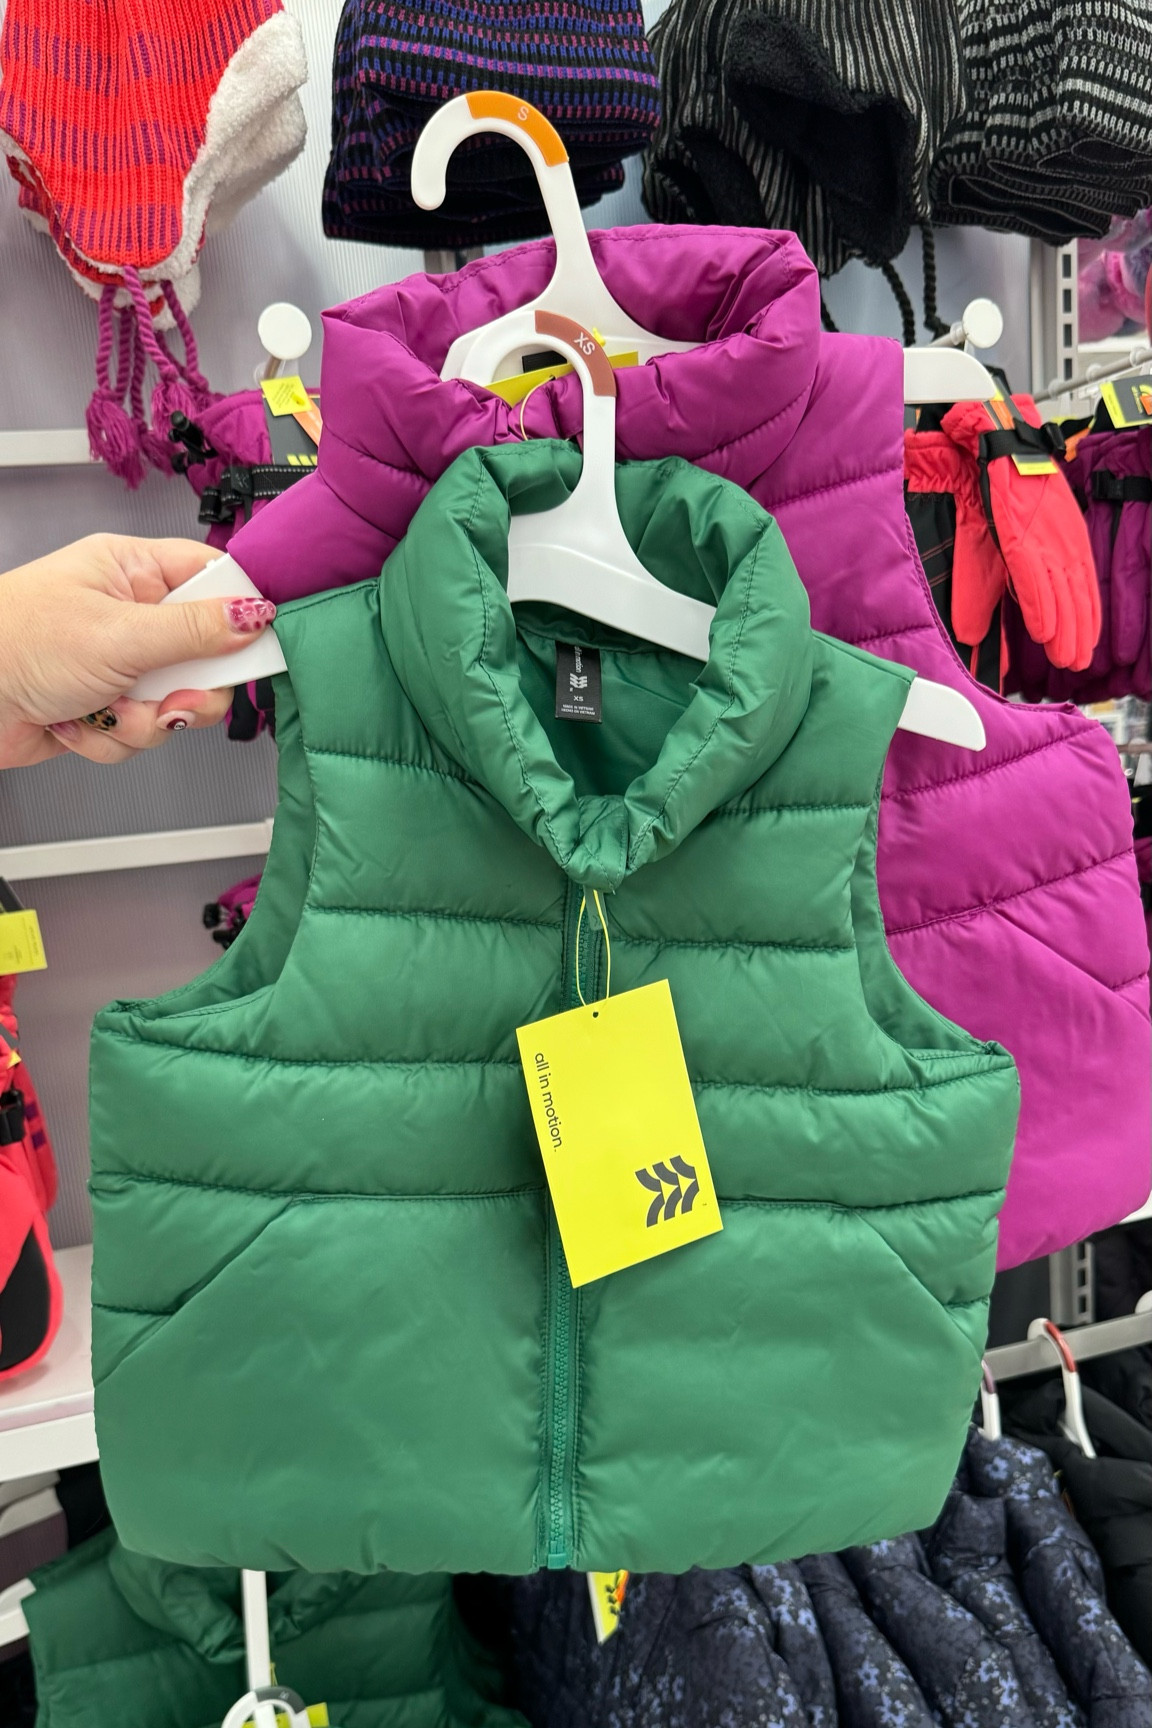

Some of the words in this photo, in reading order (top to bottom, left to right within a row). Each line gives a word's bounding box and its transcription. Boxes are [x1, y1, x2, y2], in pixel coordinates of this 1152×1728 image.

[517, 106, 529, 121] S
[574, 331, 595, 355] XS
[535, 1053, 549, 1071] all
[539, 1072, 551, 1089] in
